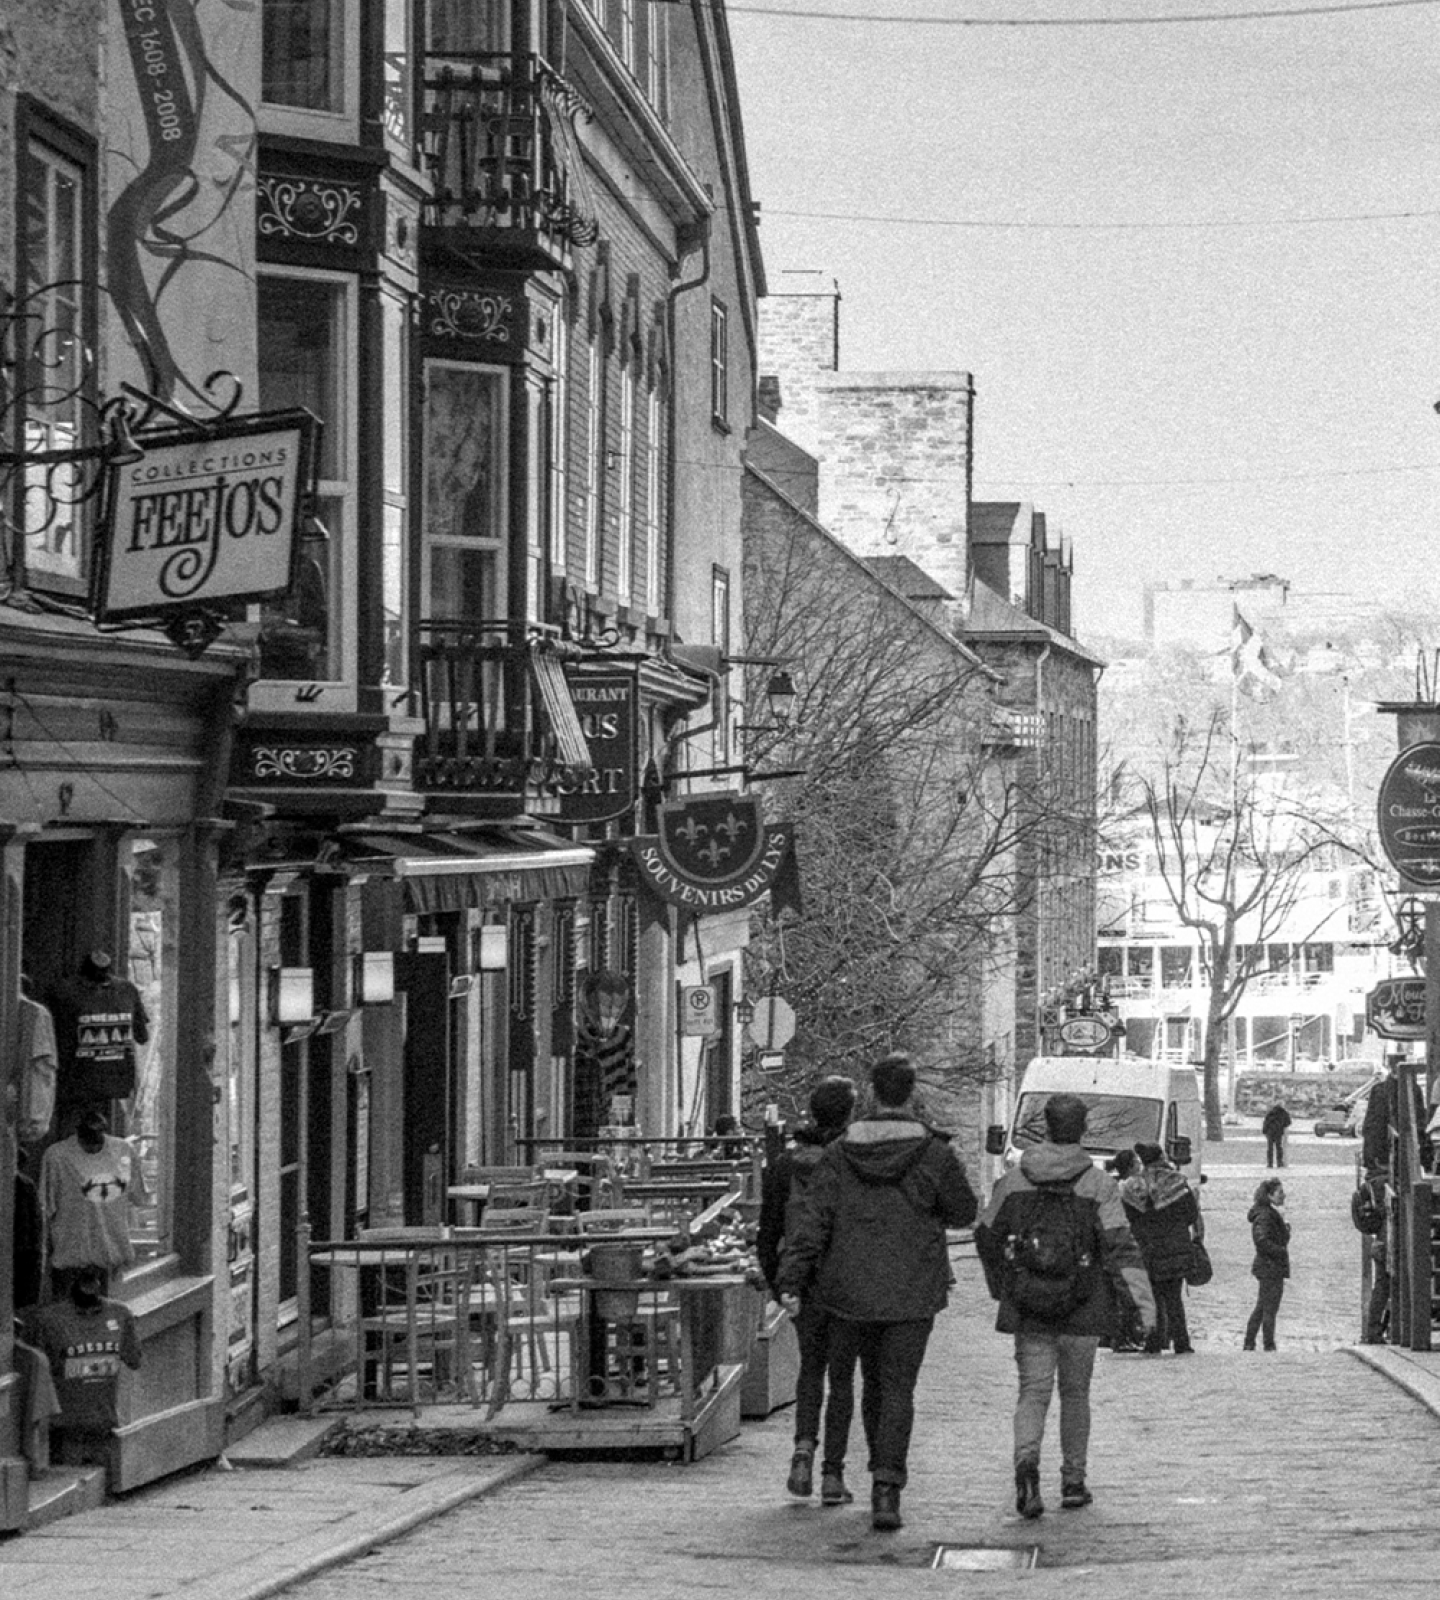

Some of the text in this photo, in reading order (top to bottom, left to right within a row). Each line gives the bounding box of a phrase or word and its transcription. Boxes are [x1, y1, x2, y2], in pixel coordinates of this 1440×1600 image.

[140, 28, 181, 140] 1608-2008
[131, 448, 287, 481] COLLECTIONS
[640, 833, 785, 906] SOUVENIRS DU LYS
